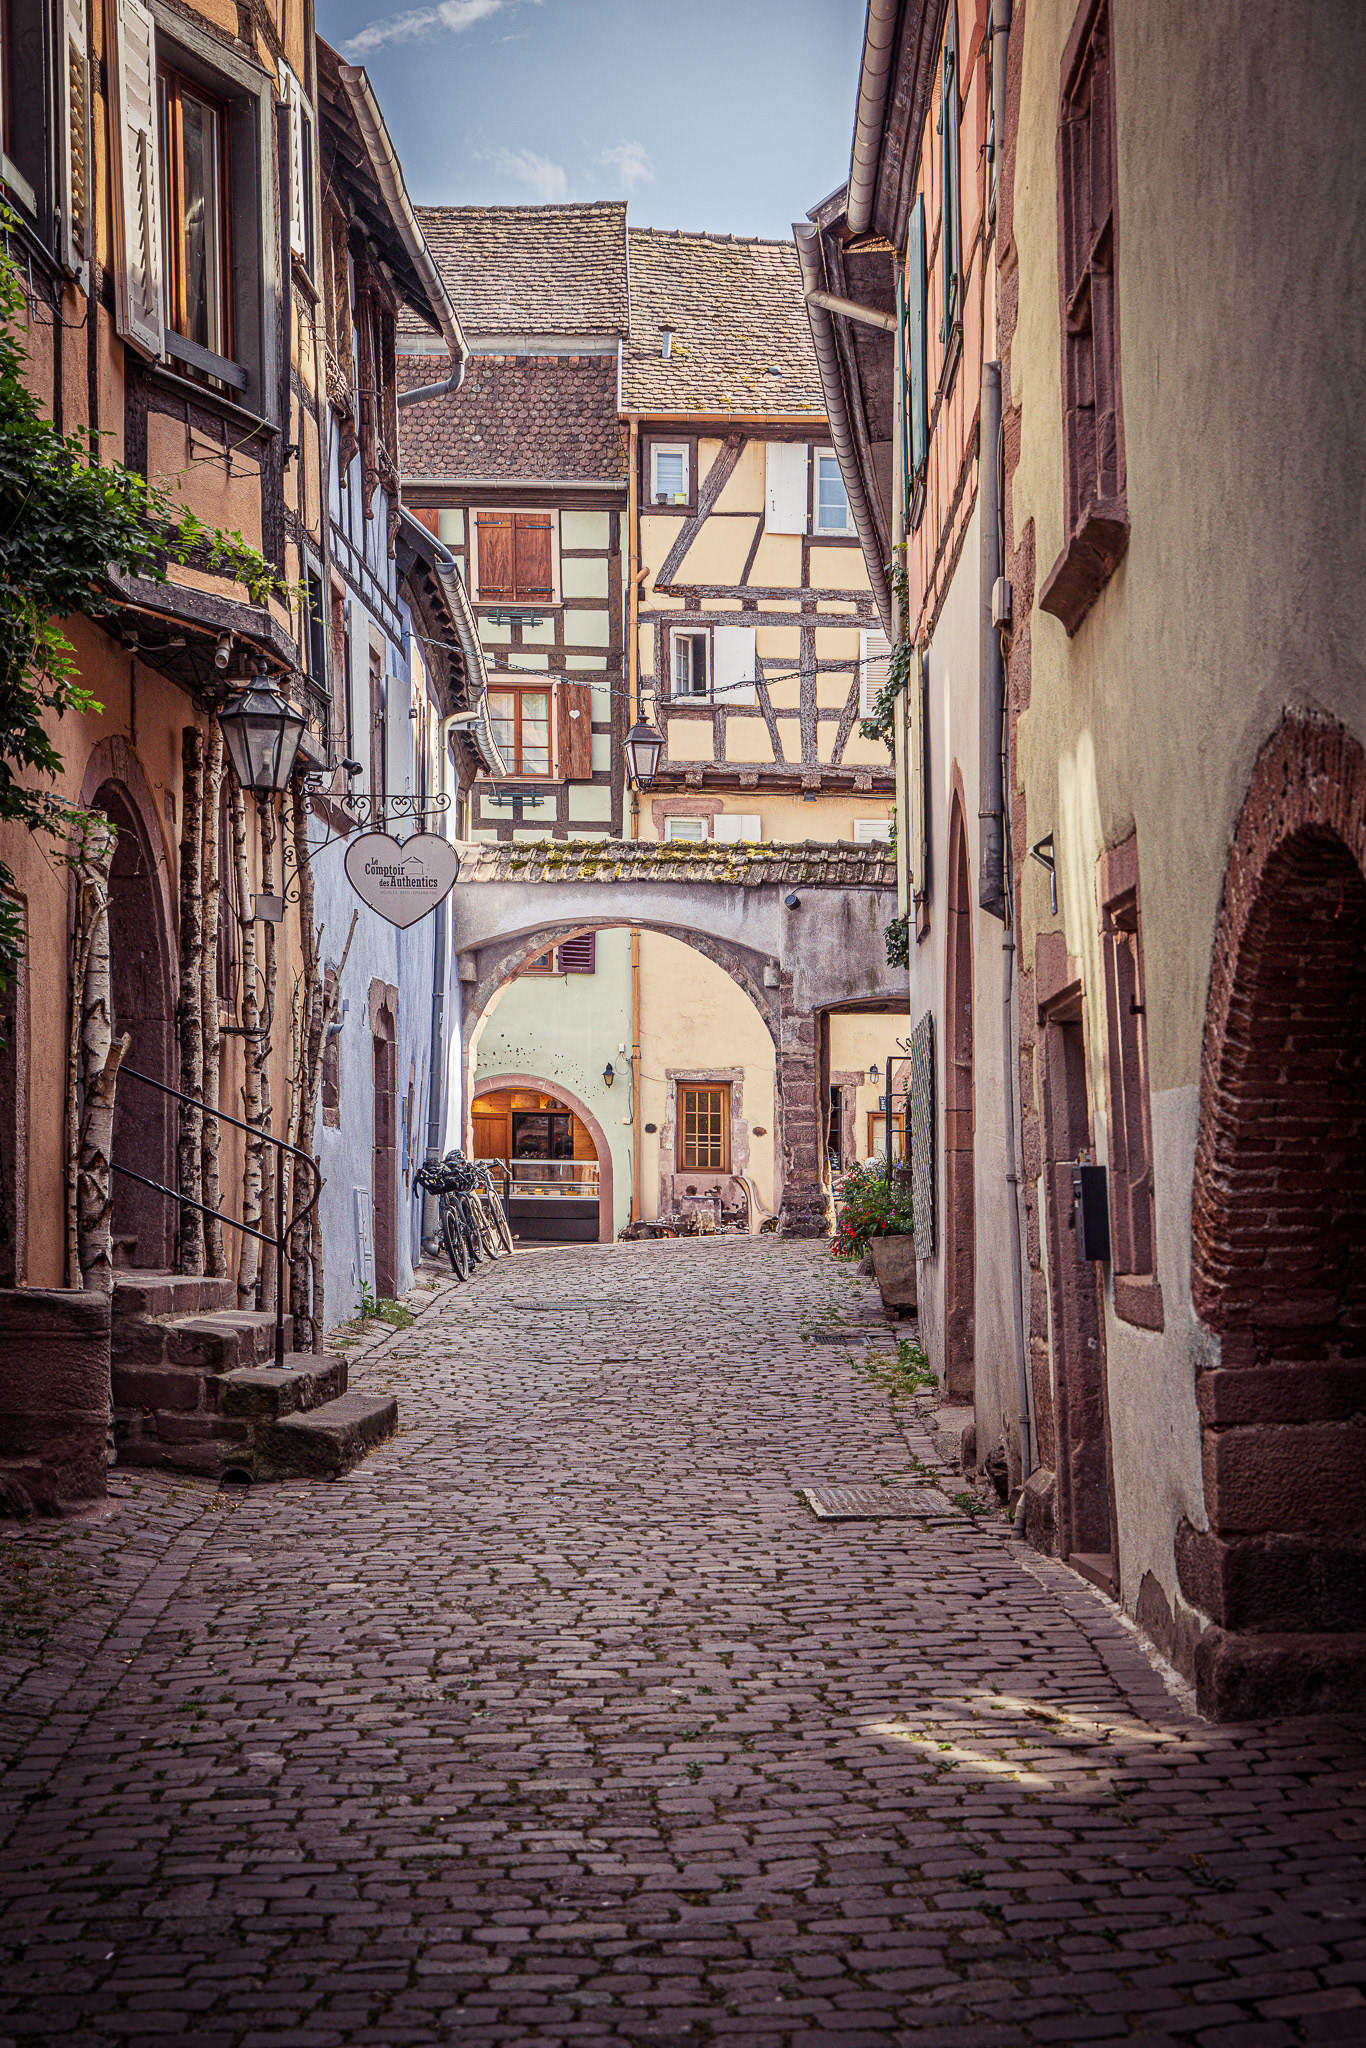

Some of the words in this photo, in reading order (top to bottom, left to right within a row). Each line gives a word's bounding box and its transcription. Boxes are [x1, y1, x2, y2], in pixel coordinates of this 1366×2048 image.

[371, 857, 378, 865] Le
[365, 863, 405, 877] Comptoir
[390, 875, 438, 887] Authentics
